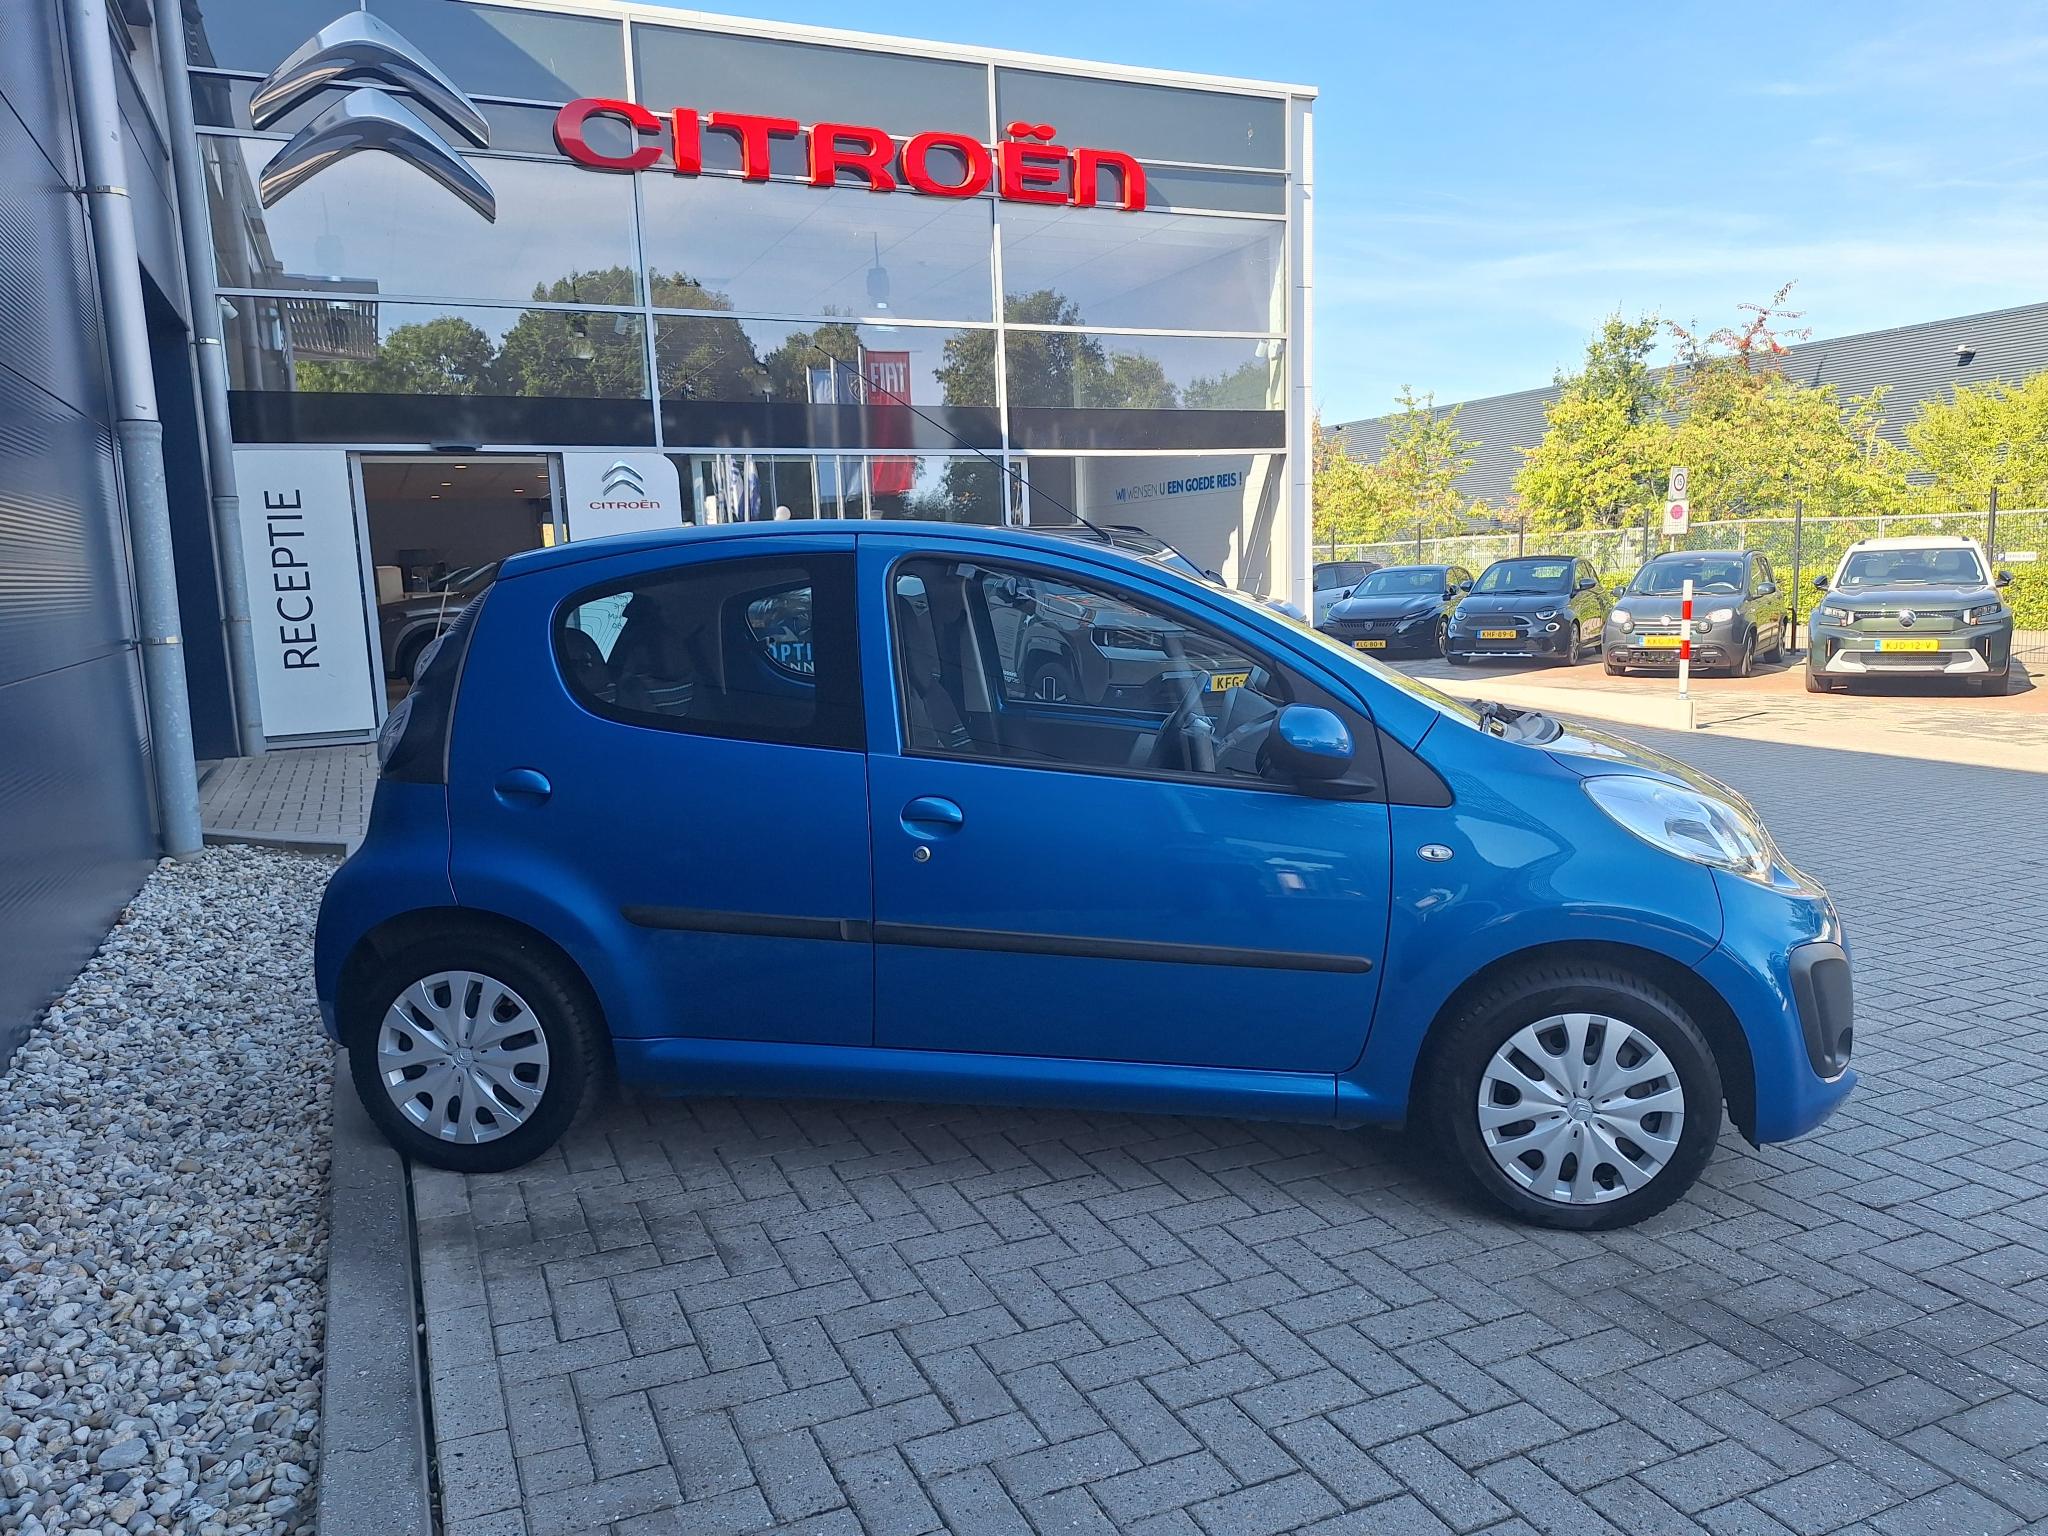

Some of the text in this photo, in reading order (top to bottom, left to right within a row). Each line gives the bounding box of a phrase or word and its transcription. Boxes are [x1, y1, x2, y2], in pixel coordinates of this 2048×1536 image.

[554, 97, 1147, 211] CITROËN
[871, 362, 906, 393] FIAT
[1128, 483, 1158, 499] WENSEN
[1160, 482, 1165, 495] U
[1167, 480, 1183, 494] EEN
[1185, 475, 1215, 492] GOEDE
[1217, 472, 1236, 488] REIS
[589, 499, 660, 510] CITROËN
[264, 489, 320, 669] RECEPTIE
